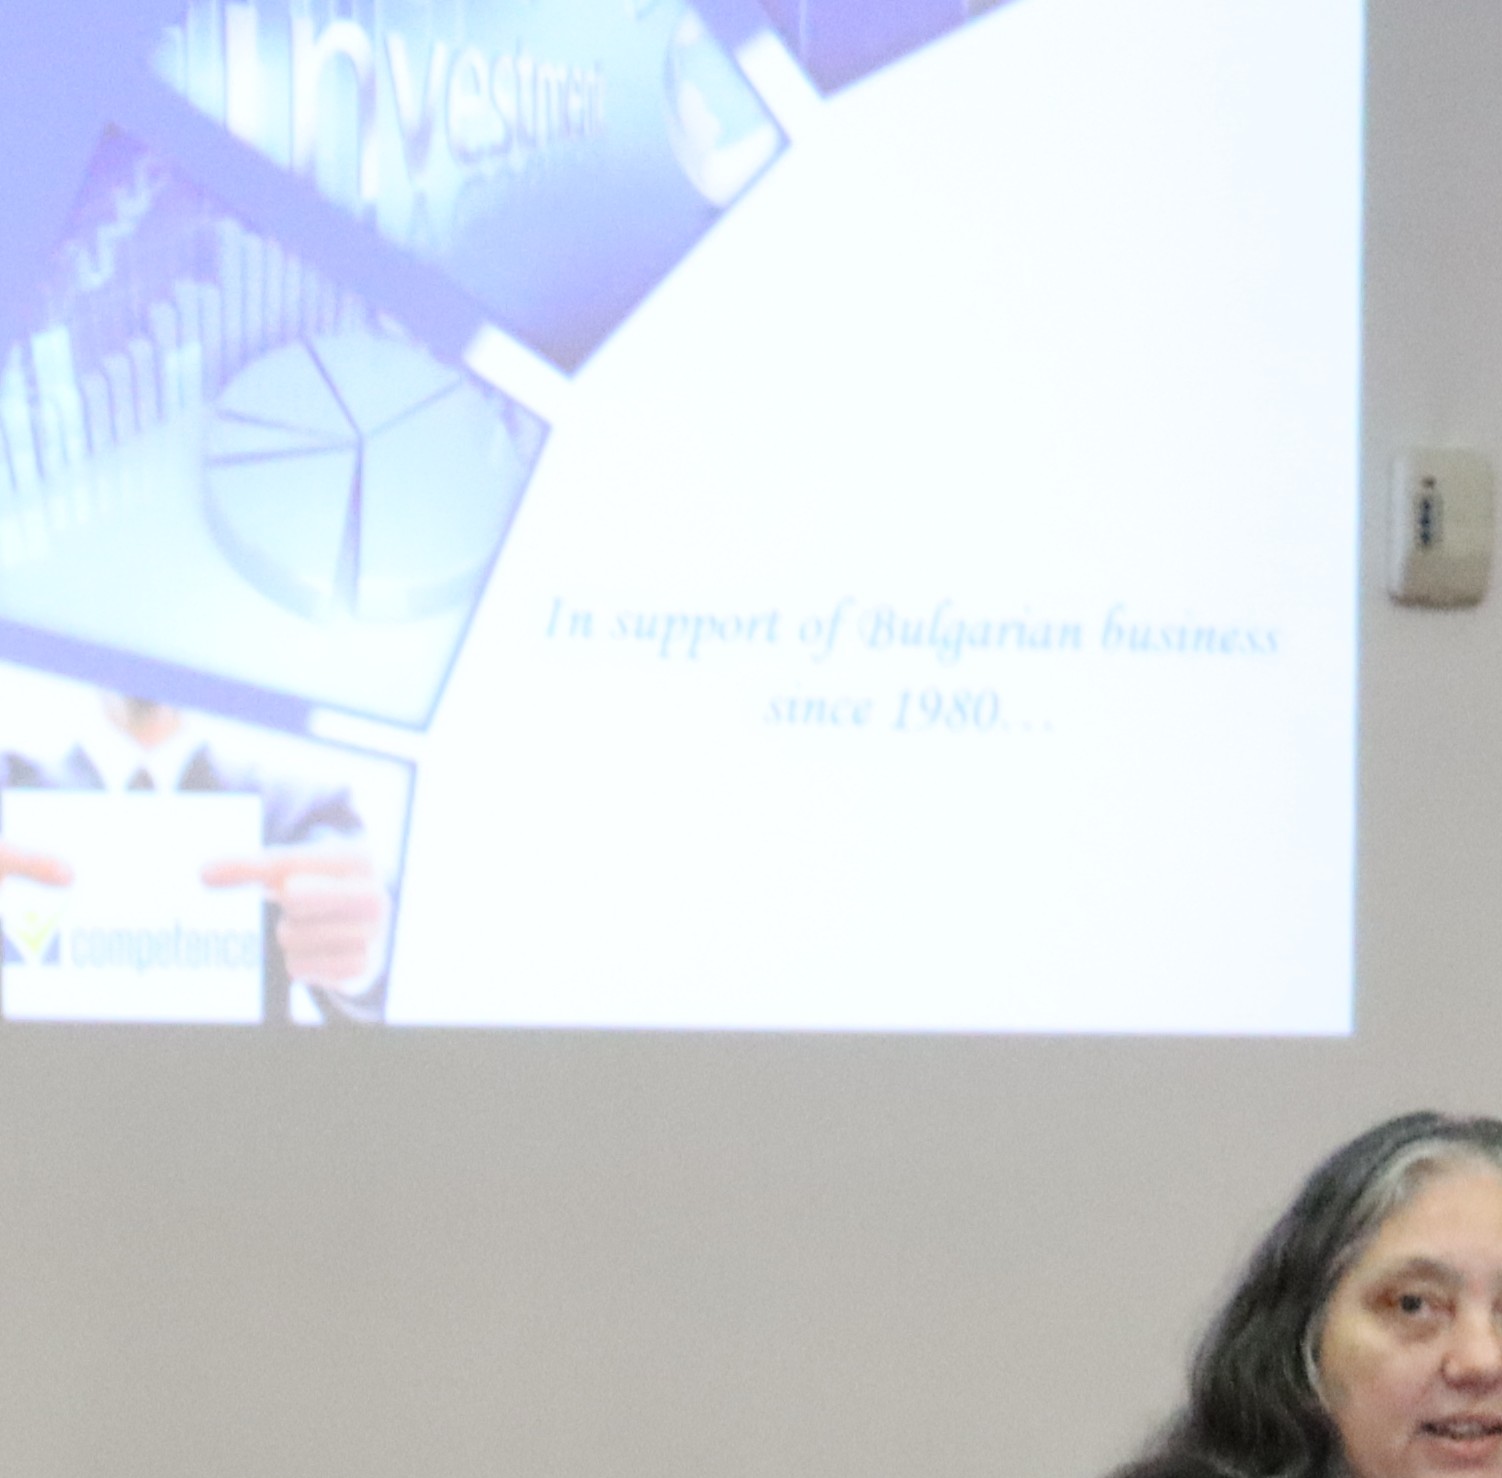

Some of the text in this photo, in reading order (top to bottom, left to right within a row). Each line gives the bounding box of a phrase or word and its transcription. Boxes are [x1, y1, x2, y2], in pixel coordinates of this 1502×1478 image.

[544, 594, 1280, 667] In support of Bulgarian business
[763, 680, 873, 729] since
[71, 919, 258, 975] competence
